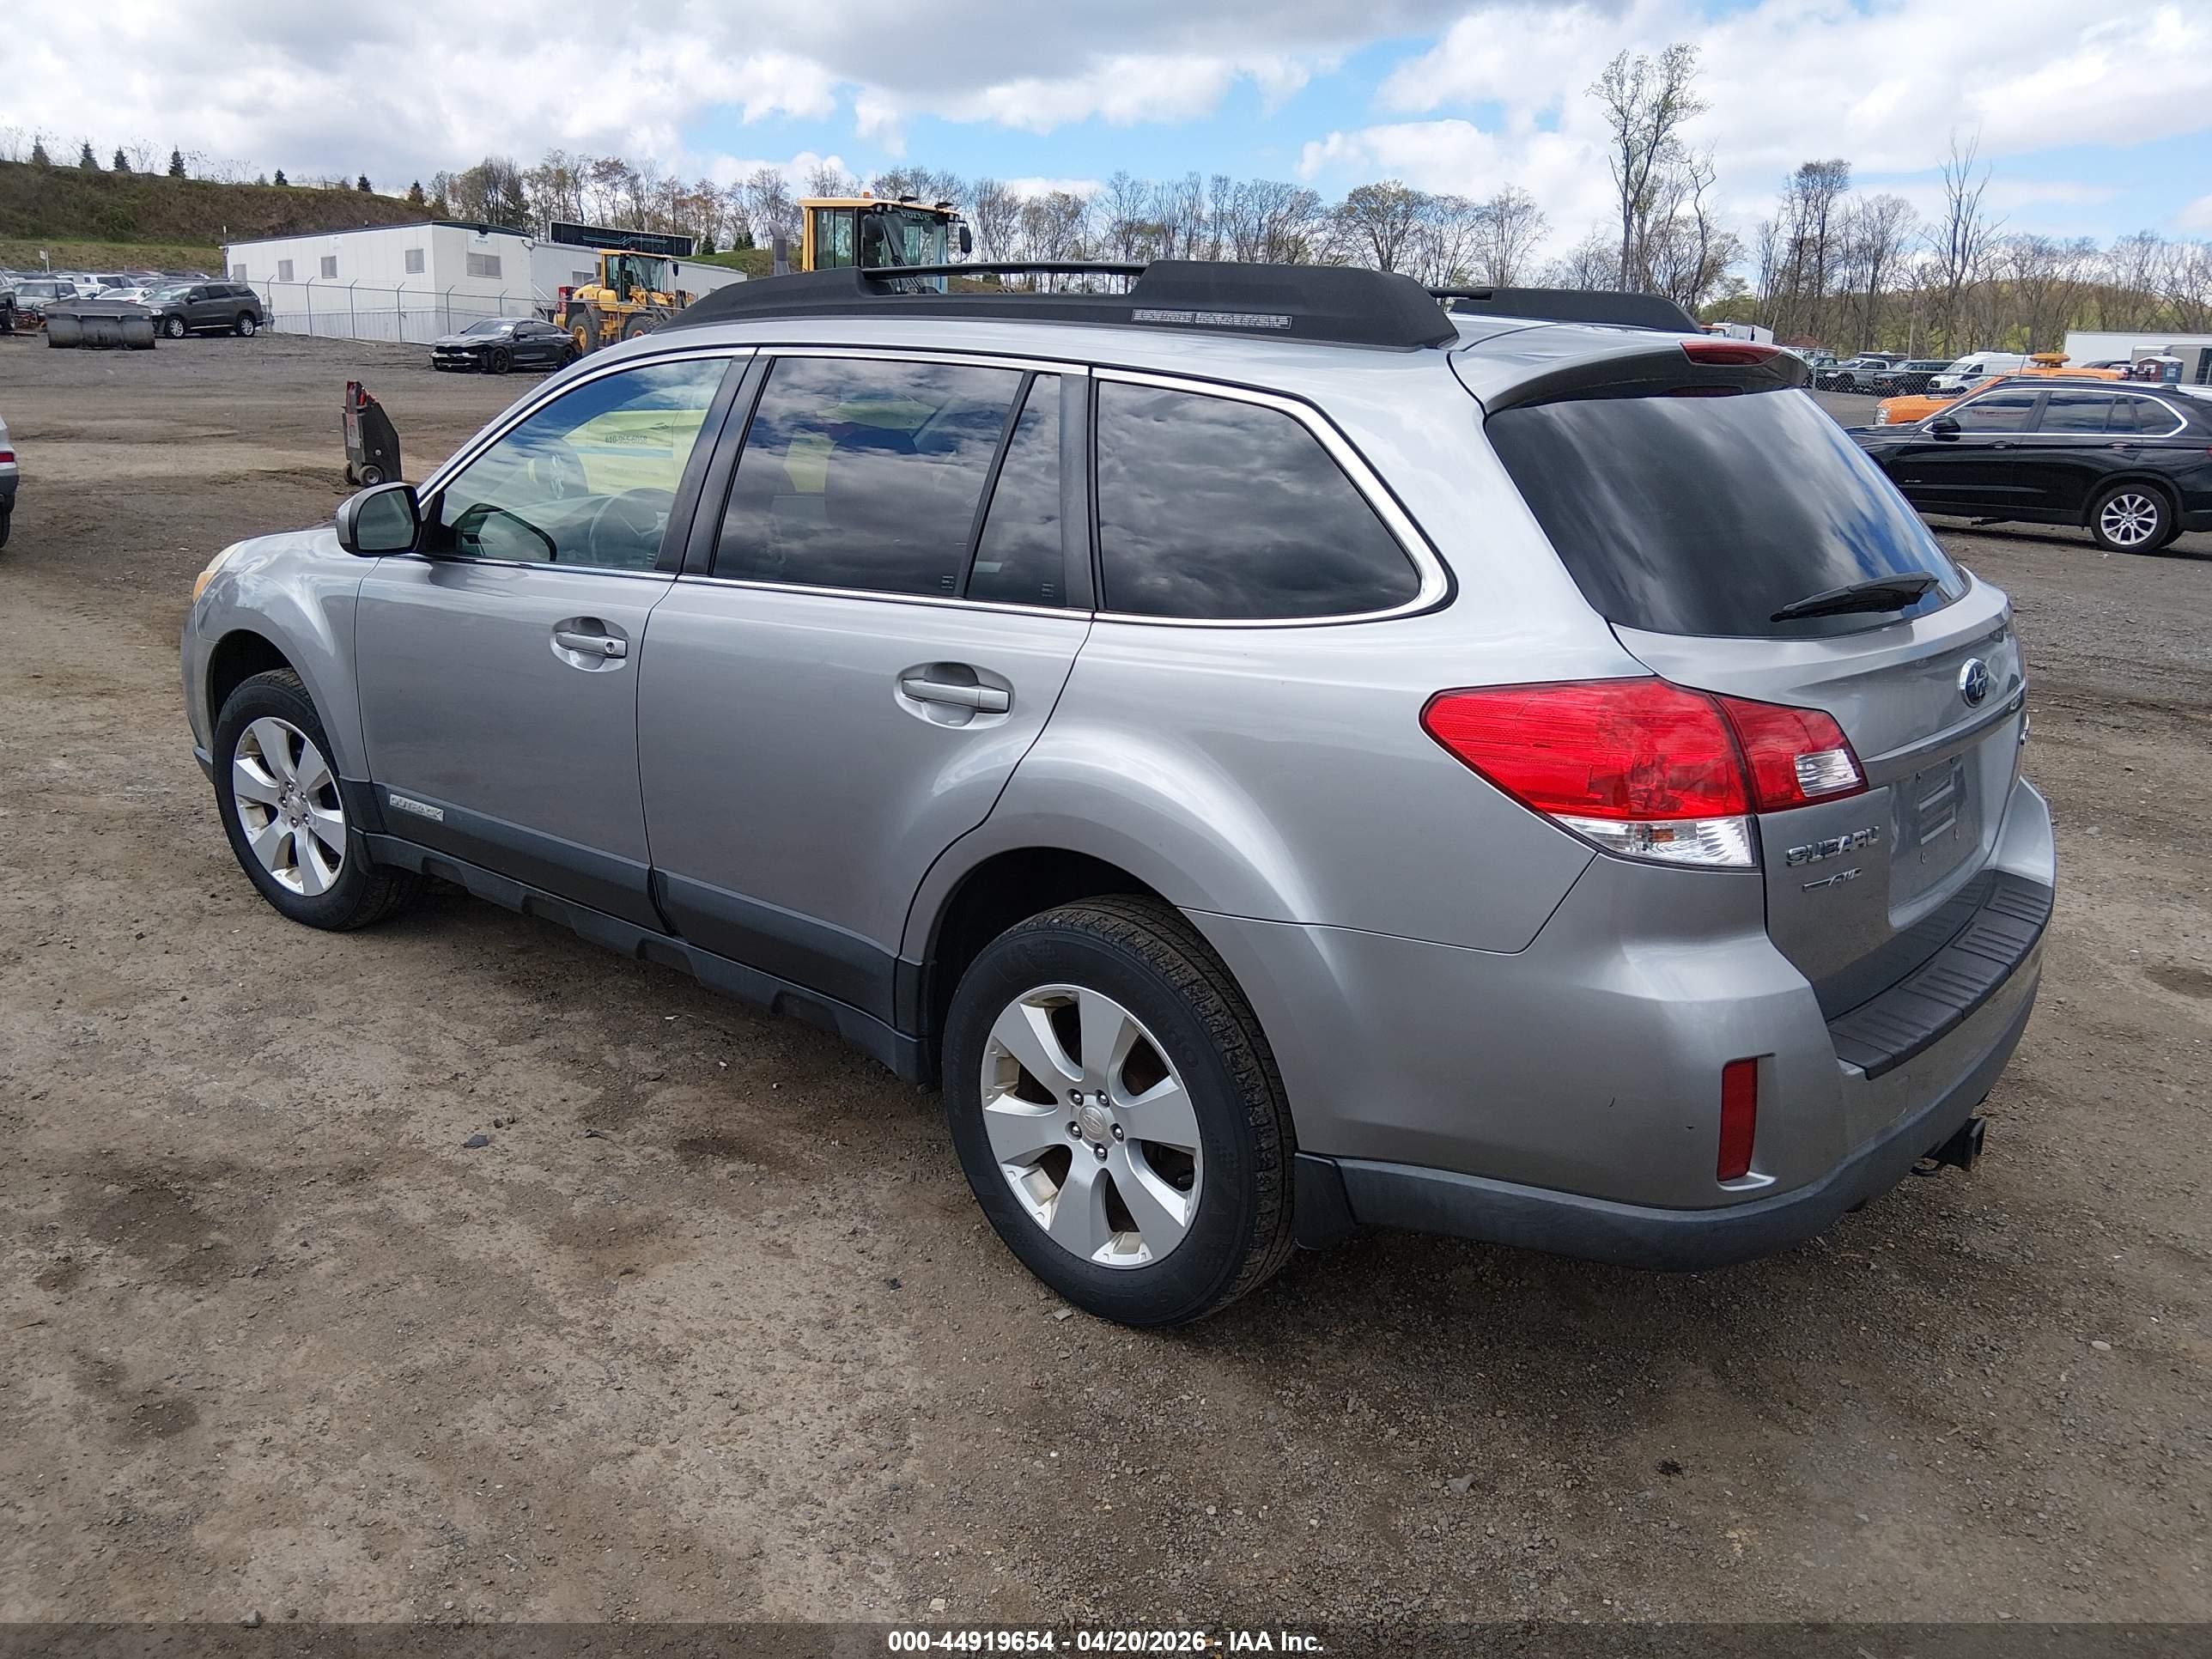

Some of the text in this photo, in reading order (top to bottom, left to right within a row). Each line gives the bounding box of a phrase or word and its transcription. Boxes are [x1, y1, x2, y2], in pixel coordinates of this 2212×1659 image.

[900, 210, 931, 221] VOLVO
[390, 794, 444, 822] OUTBACK
[1786, 825, 1881, 866] SUBARU
